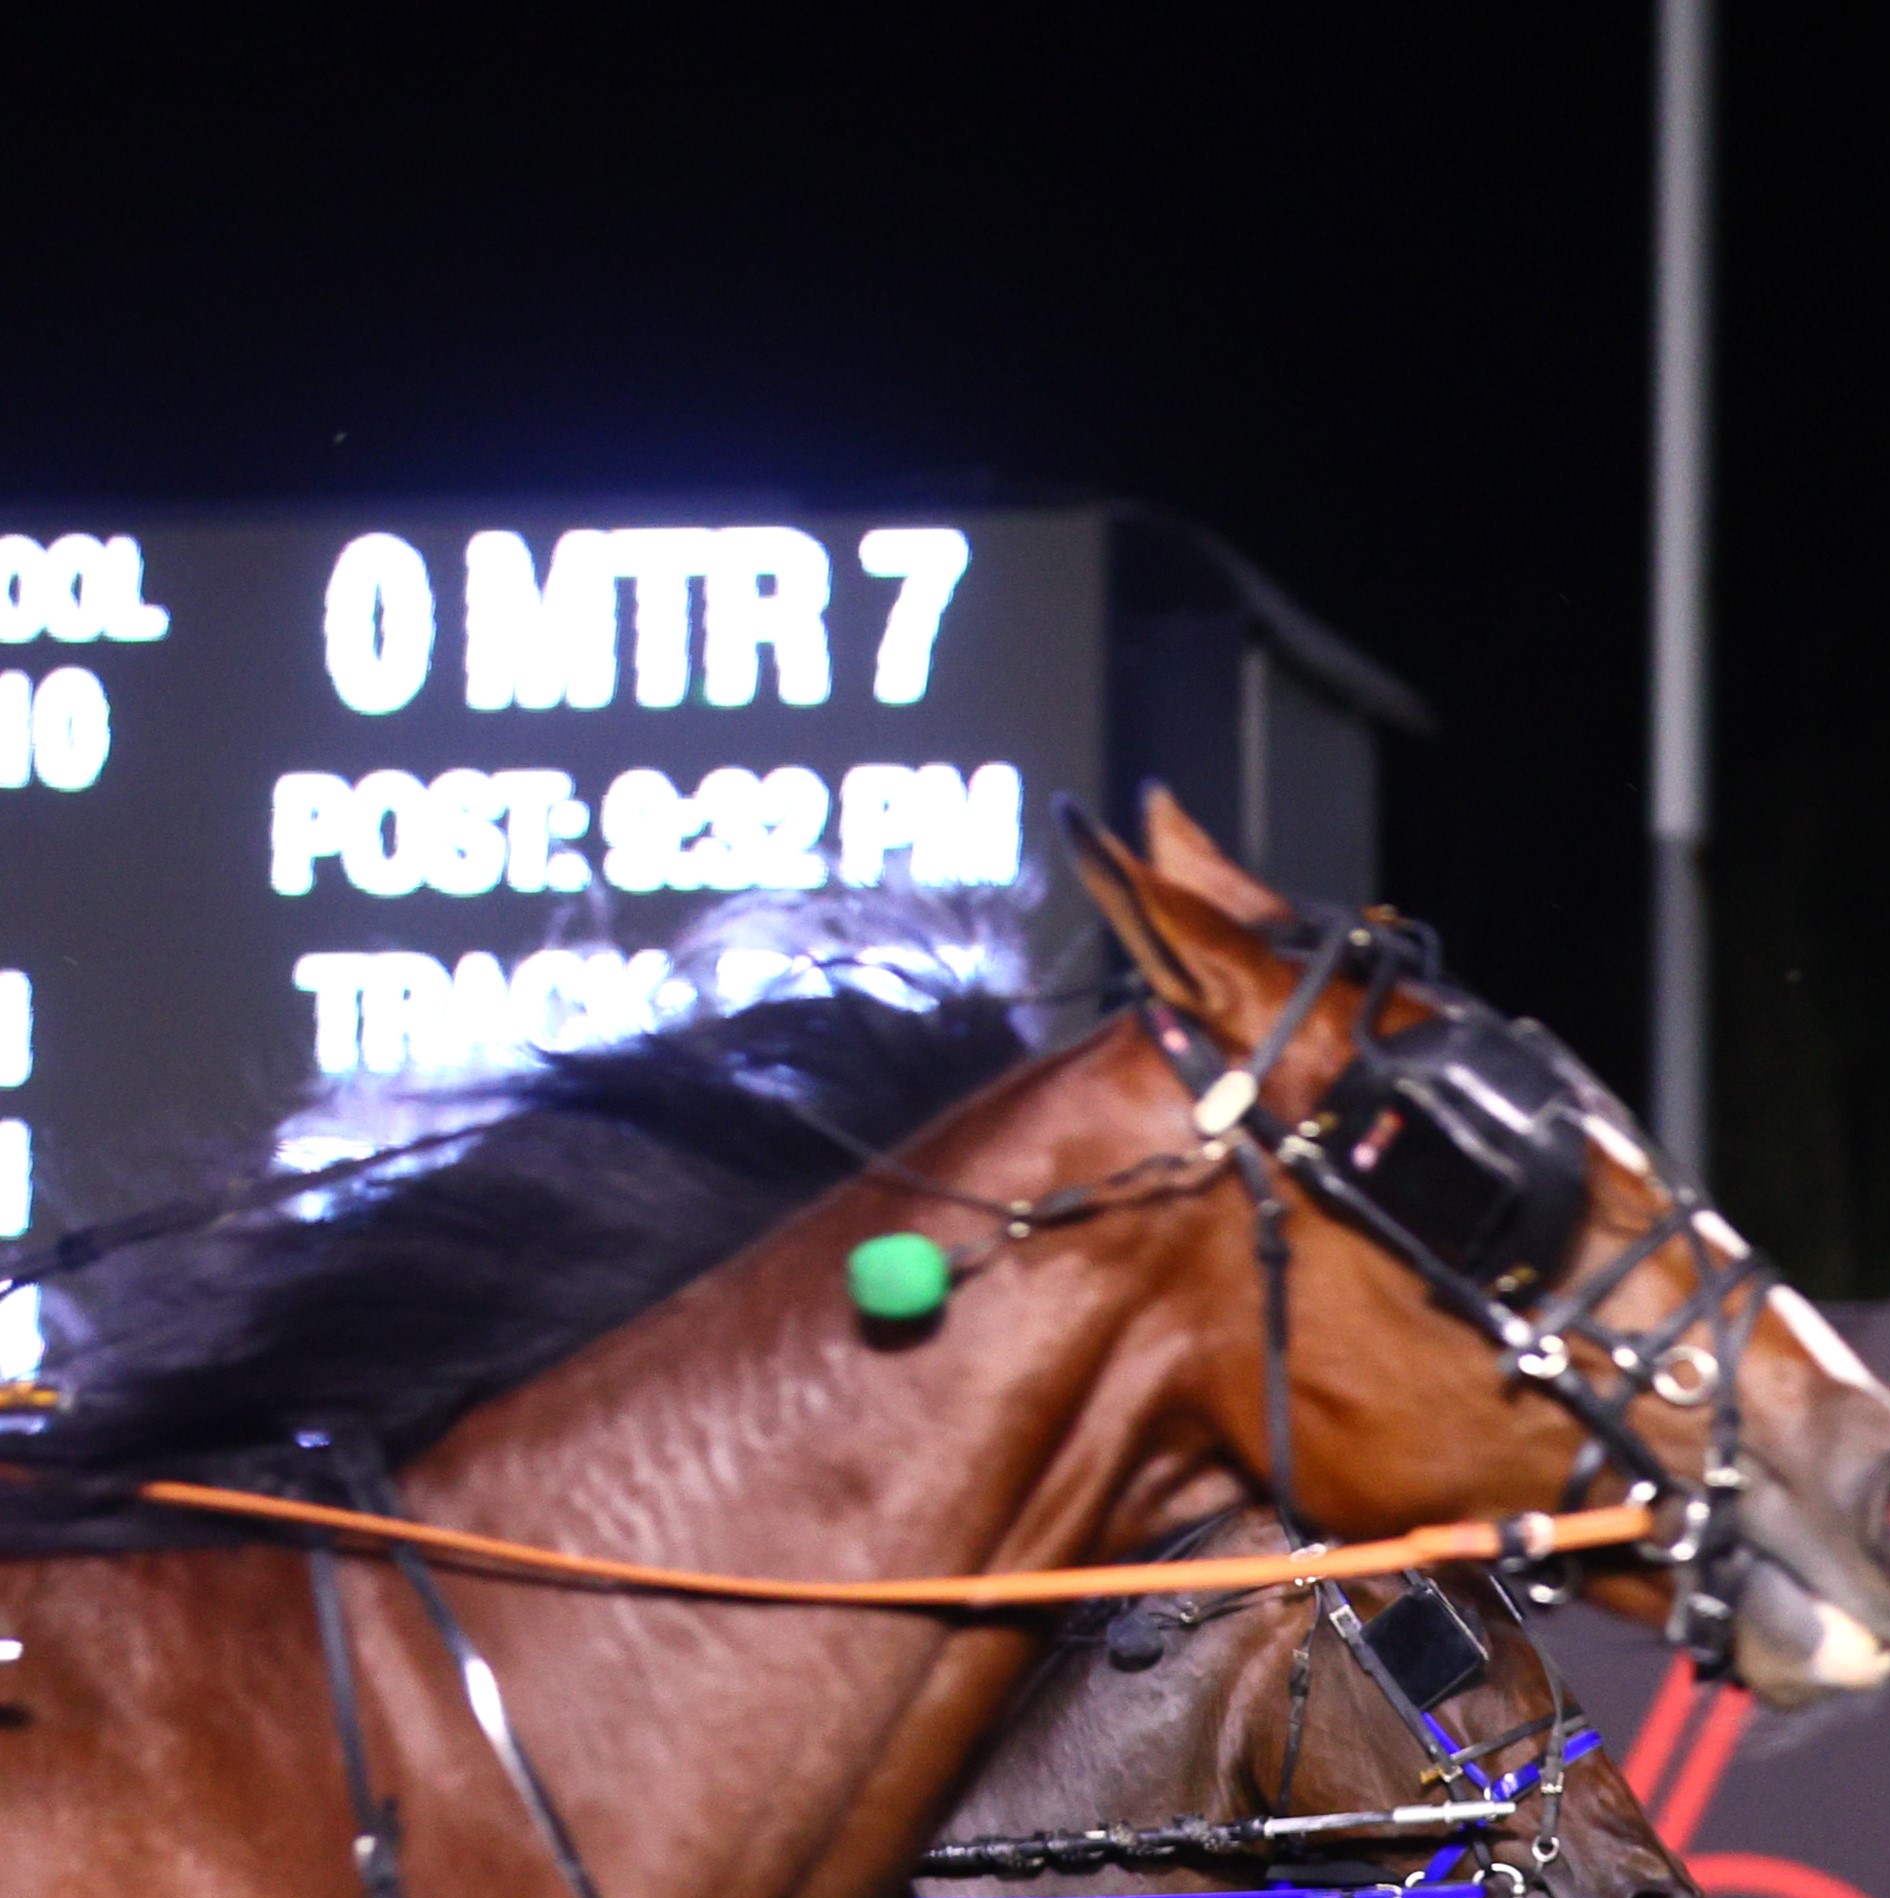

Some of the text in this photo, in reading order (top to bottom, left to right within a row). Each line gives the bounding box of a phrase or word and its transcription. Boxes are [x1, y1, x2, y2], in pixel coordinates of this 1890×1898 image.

[324, 526, 969, 712] 0 MTR 7
[271, 769, 592, 895] POST:
[838, 763, 1021, 888] PM
